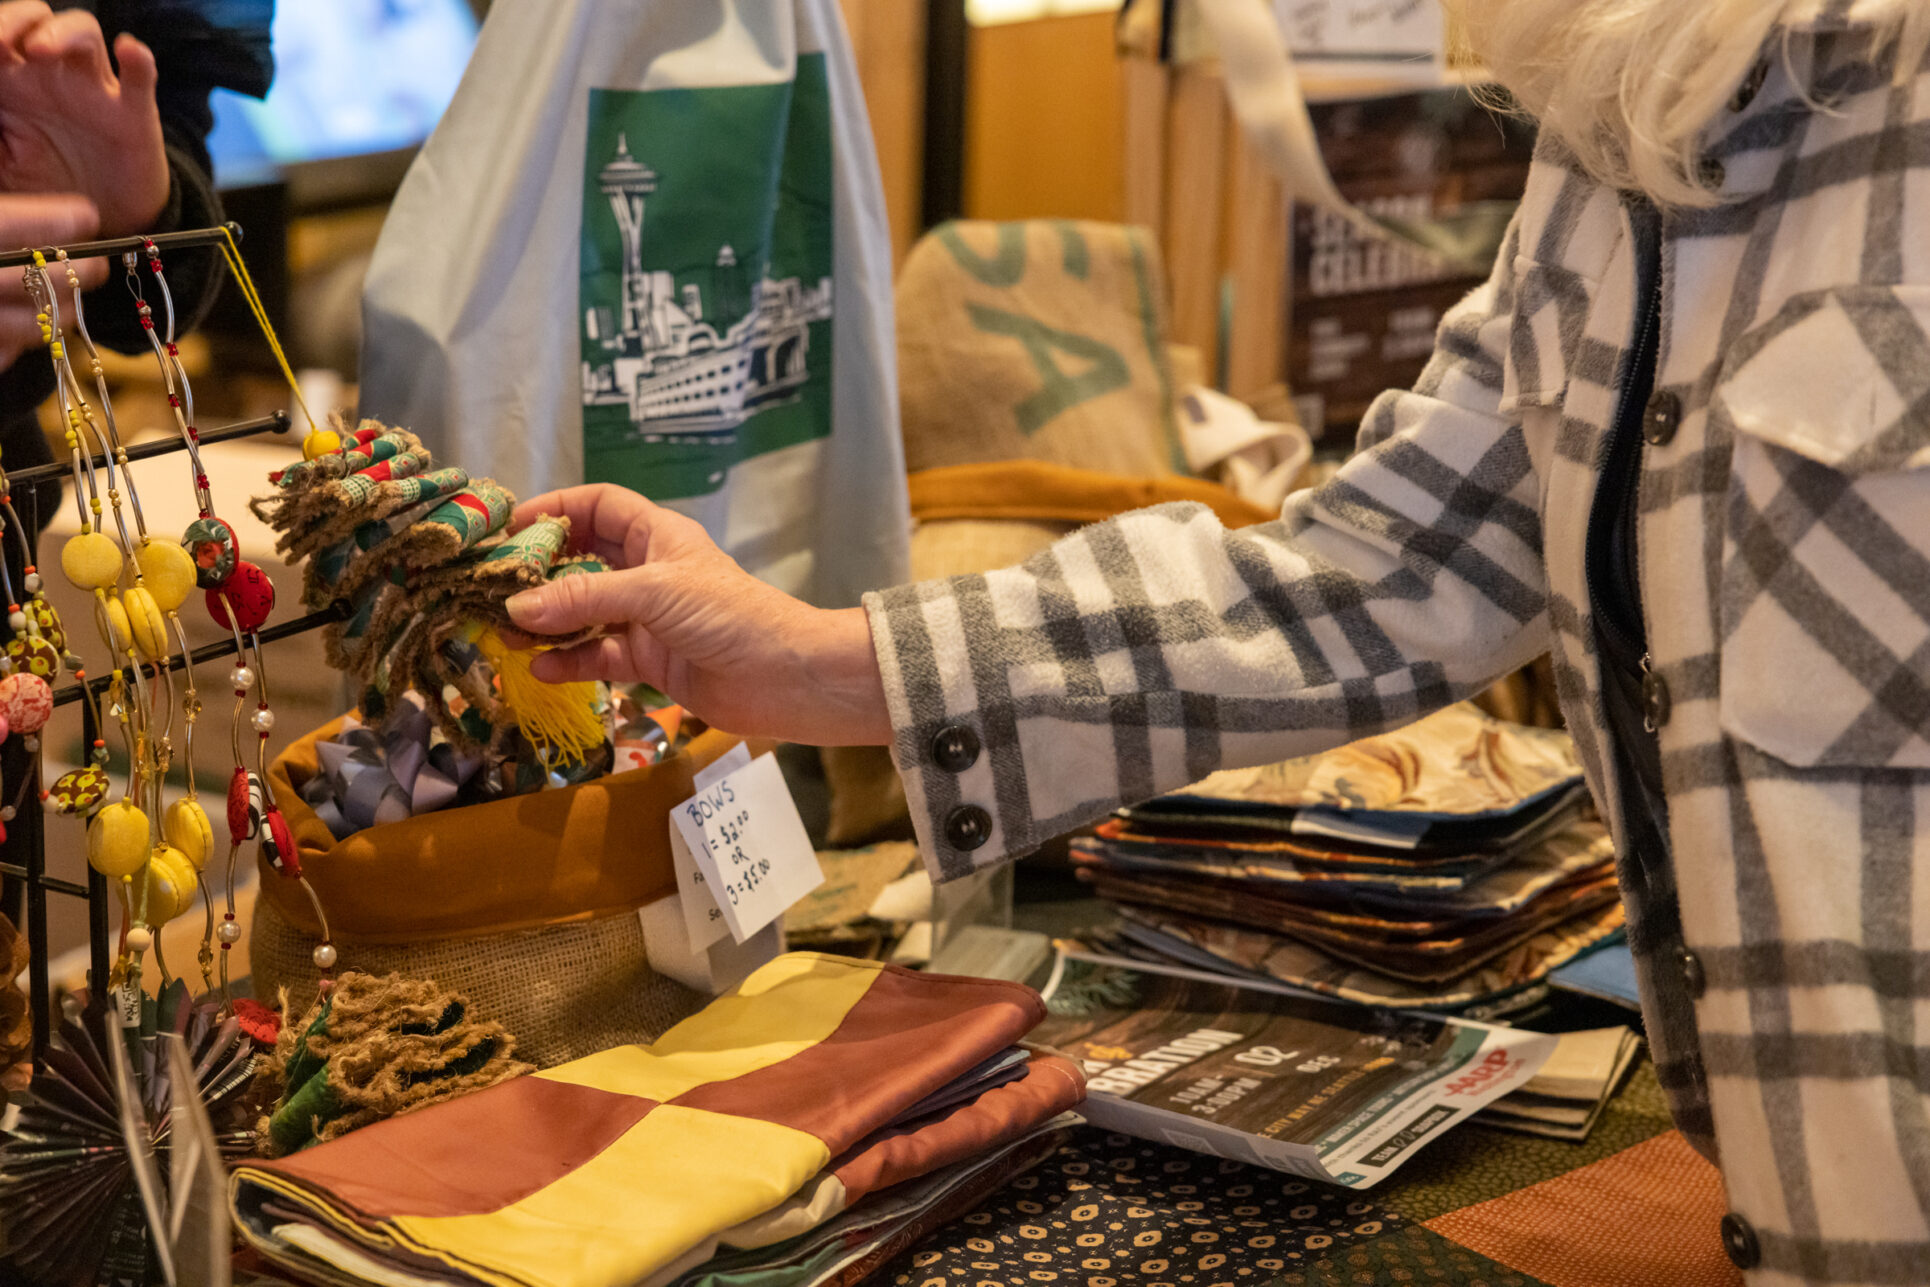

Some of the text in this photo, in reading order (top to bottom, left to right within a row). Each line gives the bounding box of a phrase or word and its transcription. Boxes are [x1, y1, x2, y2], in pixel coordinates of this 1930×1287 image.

[686, 780, 735, 827] BOWS
[732, 846, 750, 865] OR
[1085, 1028, 1245, 1096] BRATION
[1233, 1045, 1300, 1066] 02
[1444, 1046, 1508, 1096] AARP
[1370, 1145, 1399, 1161] TEAM
